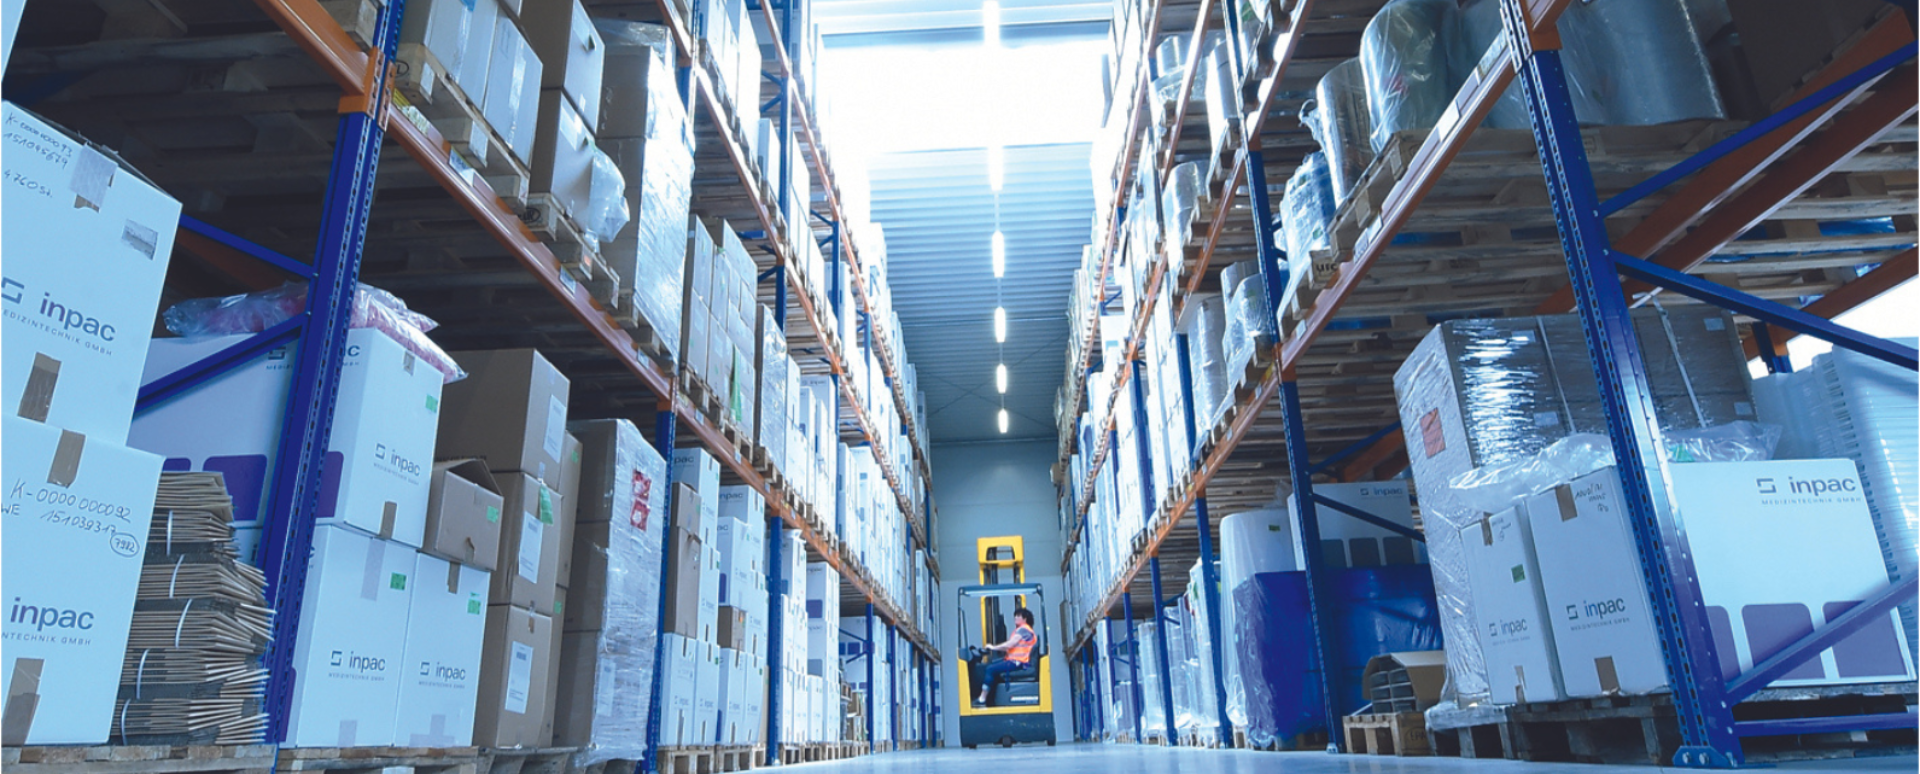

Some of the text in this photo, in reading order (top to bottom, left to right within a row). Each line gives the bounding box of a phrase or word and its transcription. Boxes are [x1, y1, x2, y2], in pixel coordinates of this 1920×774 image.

[40, 291, 116, 342] inpac
[390, 448, 421, 477] inpac
[1787, 476, 1856, 496] inpac
[10, 597, 94, 632] inpac
[1583, 598, 1626, 620] inpac
[1500, 619, 1528, 637] inpac
[349, 650, 386, 673] inpac
[436, 661, 466, 682] inpac
